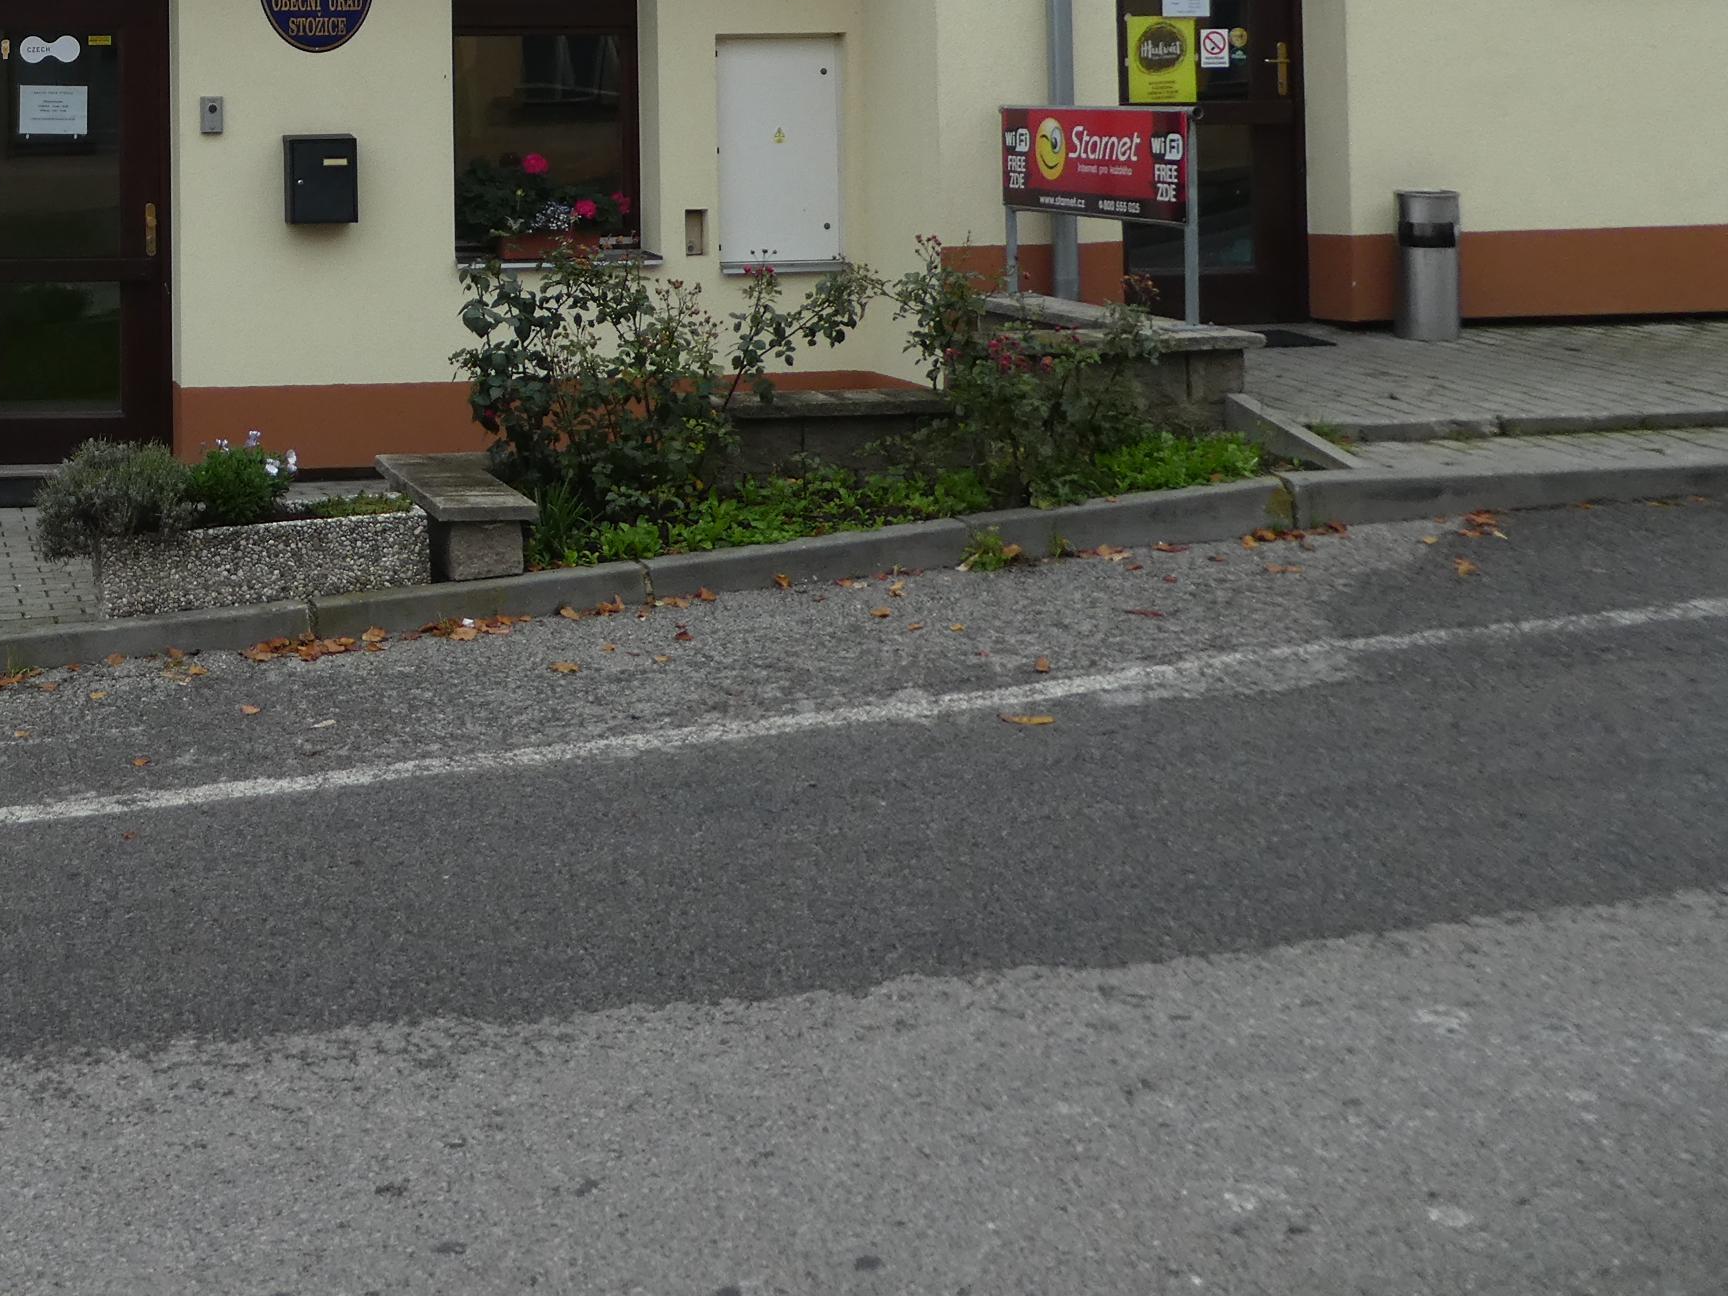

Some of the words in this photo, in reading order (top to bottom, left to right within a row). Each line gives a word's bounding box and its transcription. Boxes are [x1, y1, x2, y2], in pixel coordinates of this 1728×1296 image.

[288, 11, 347, 36] STOŽICE
[1068, 125, 1140, 162] Starnet
[1008, 155, 1026, 172] FREE
[1009, 173, 1025, 189] ZDE
[1154, 164, 1179, 183] FREE
[1156, 184, 1177, 202] ZDE
